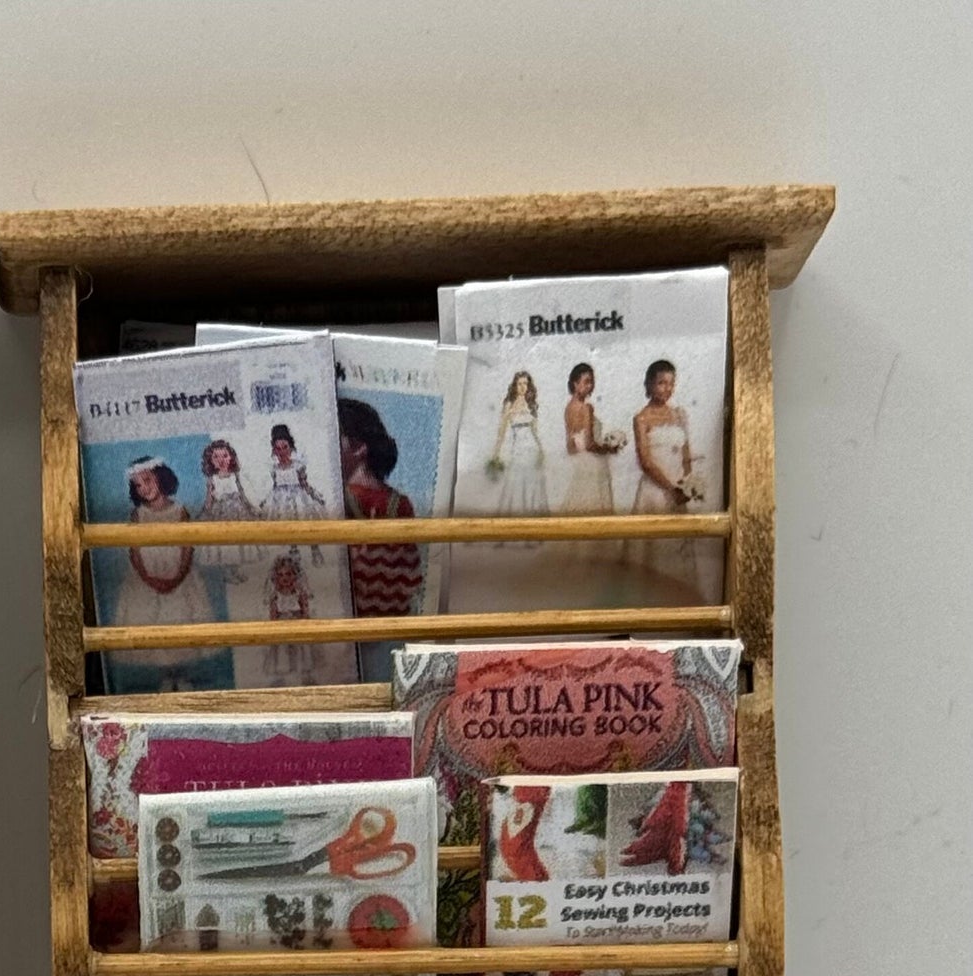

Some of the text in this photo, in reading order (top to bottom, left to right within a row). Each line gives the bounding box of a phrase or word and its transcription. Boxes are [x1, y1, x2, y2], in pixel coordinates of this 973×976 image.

[529, 309, 624, 337] Butterick
[144, 386, 237, 415] Butterick
[482, 684, 573, 717] TULA
[582, 682, 665, 714] PINK
[462, 713, 663, 741] COLORING BOOK
[563, 880, 711, 901] Easy Christmas
[493, 893, 548, 931] 12
[560, 901, 712, 923] Sewing Projects
